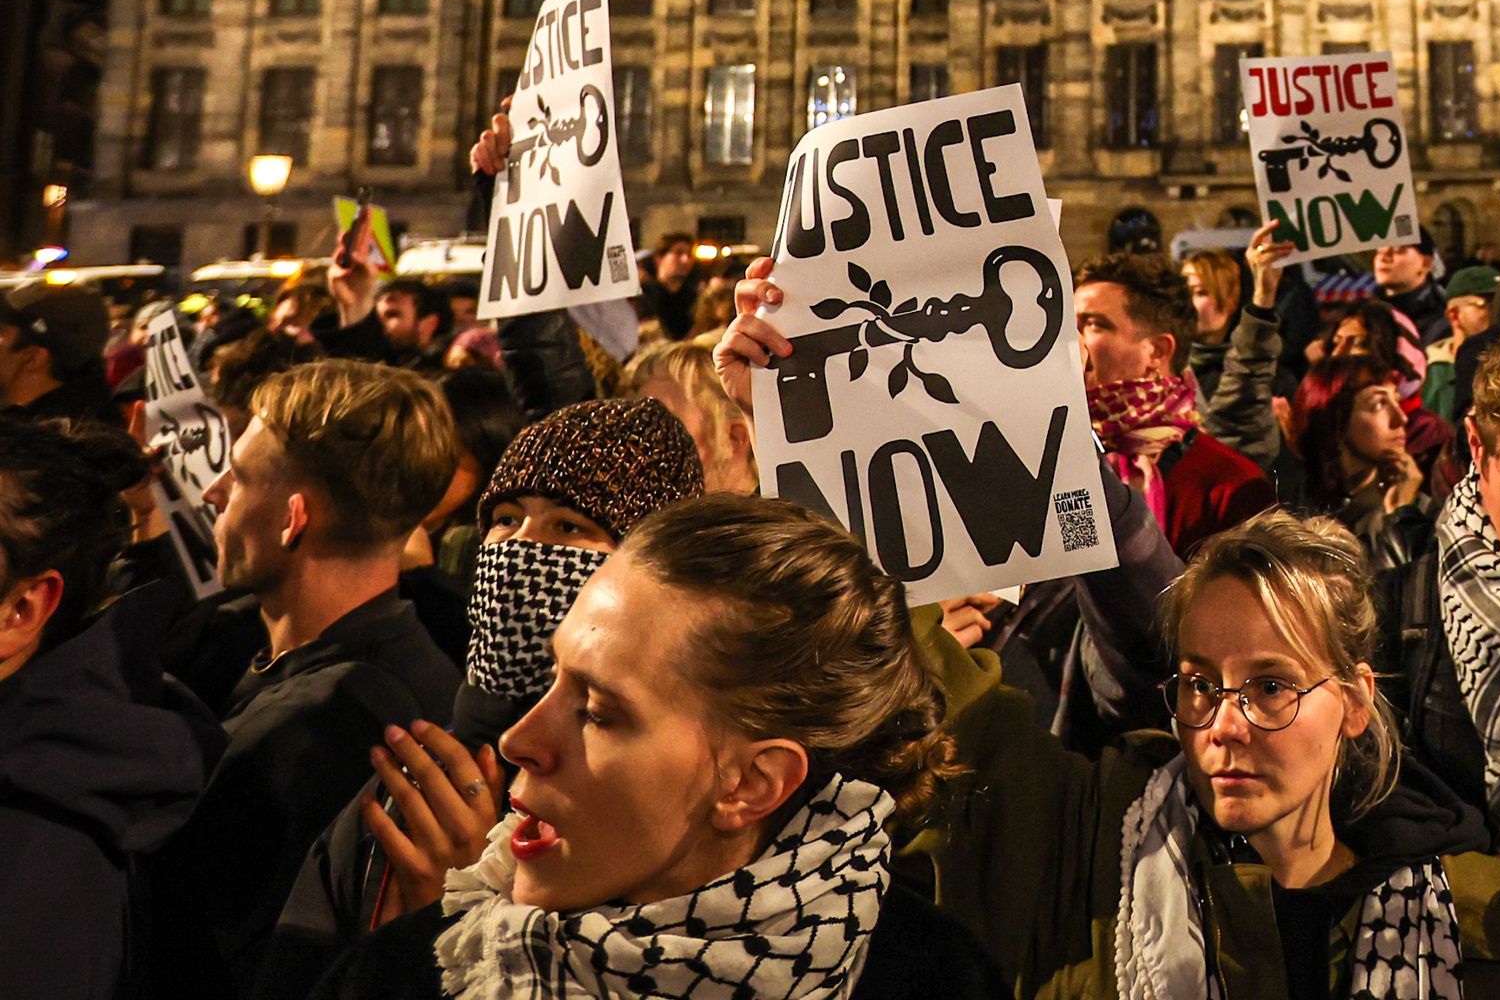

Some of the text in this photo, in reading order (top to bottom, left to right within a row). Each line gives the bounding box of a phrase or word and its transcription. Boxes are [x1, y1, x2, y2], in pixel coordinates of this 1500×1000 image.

[1249, 61, 1394, 117] JUSTICE
[488, 191, 614, 302] NOW
[1267, 183, 1404, 252] NOW
[776, 405, 1068, 582] NOW
[1055, 496, 1092, 514] DONATE
